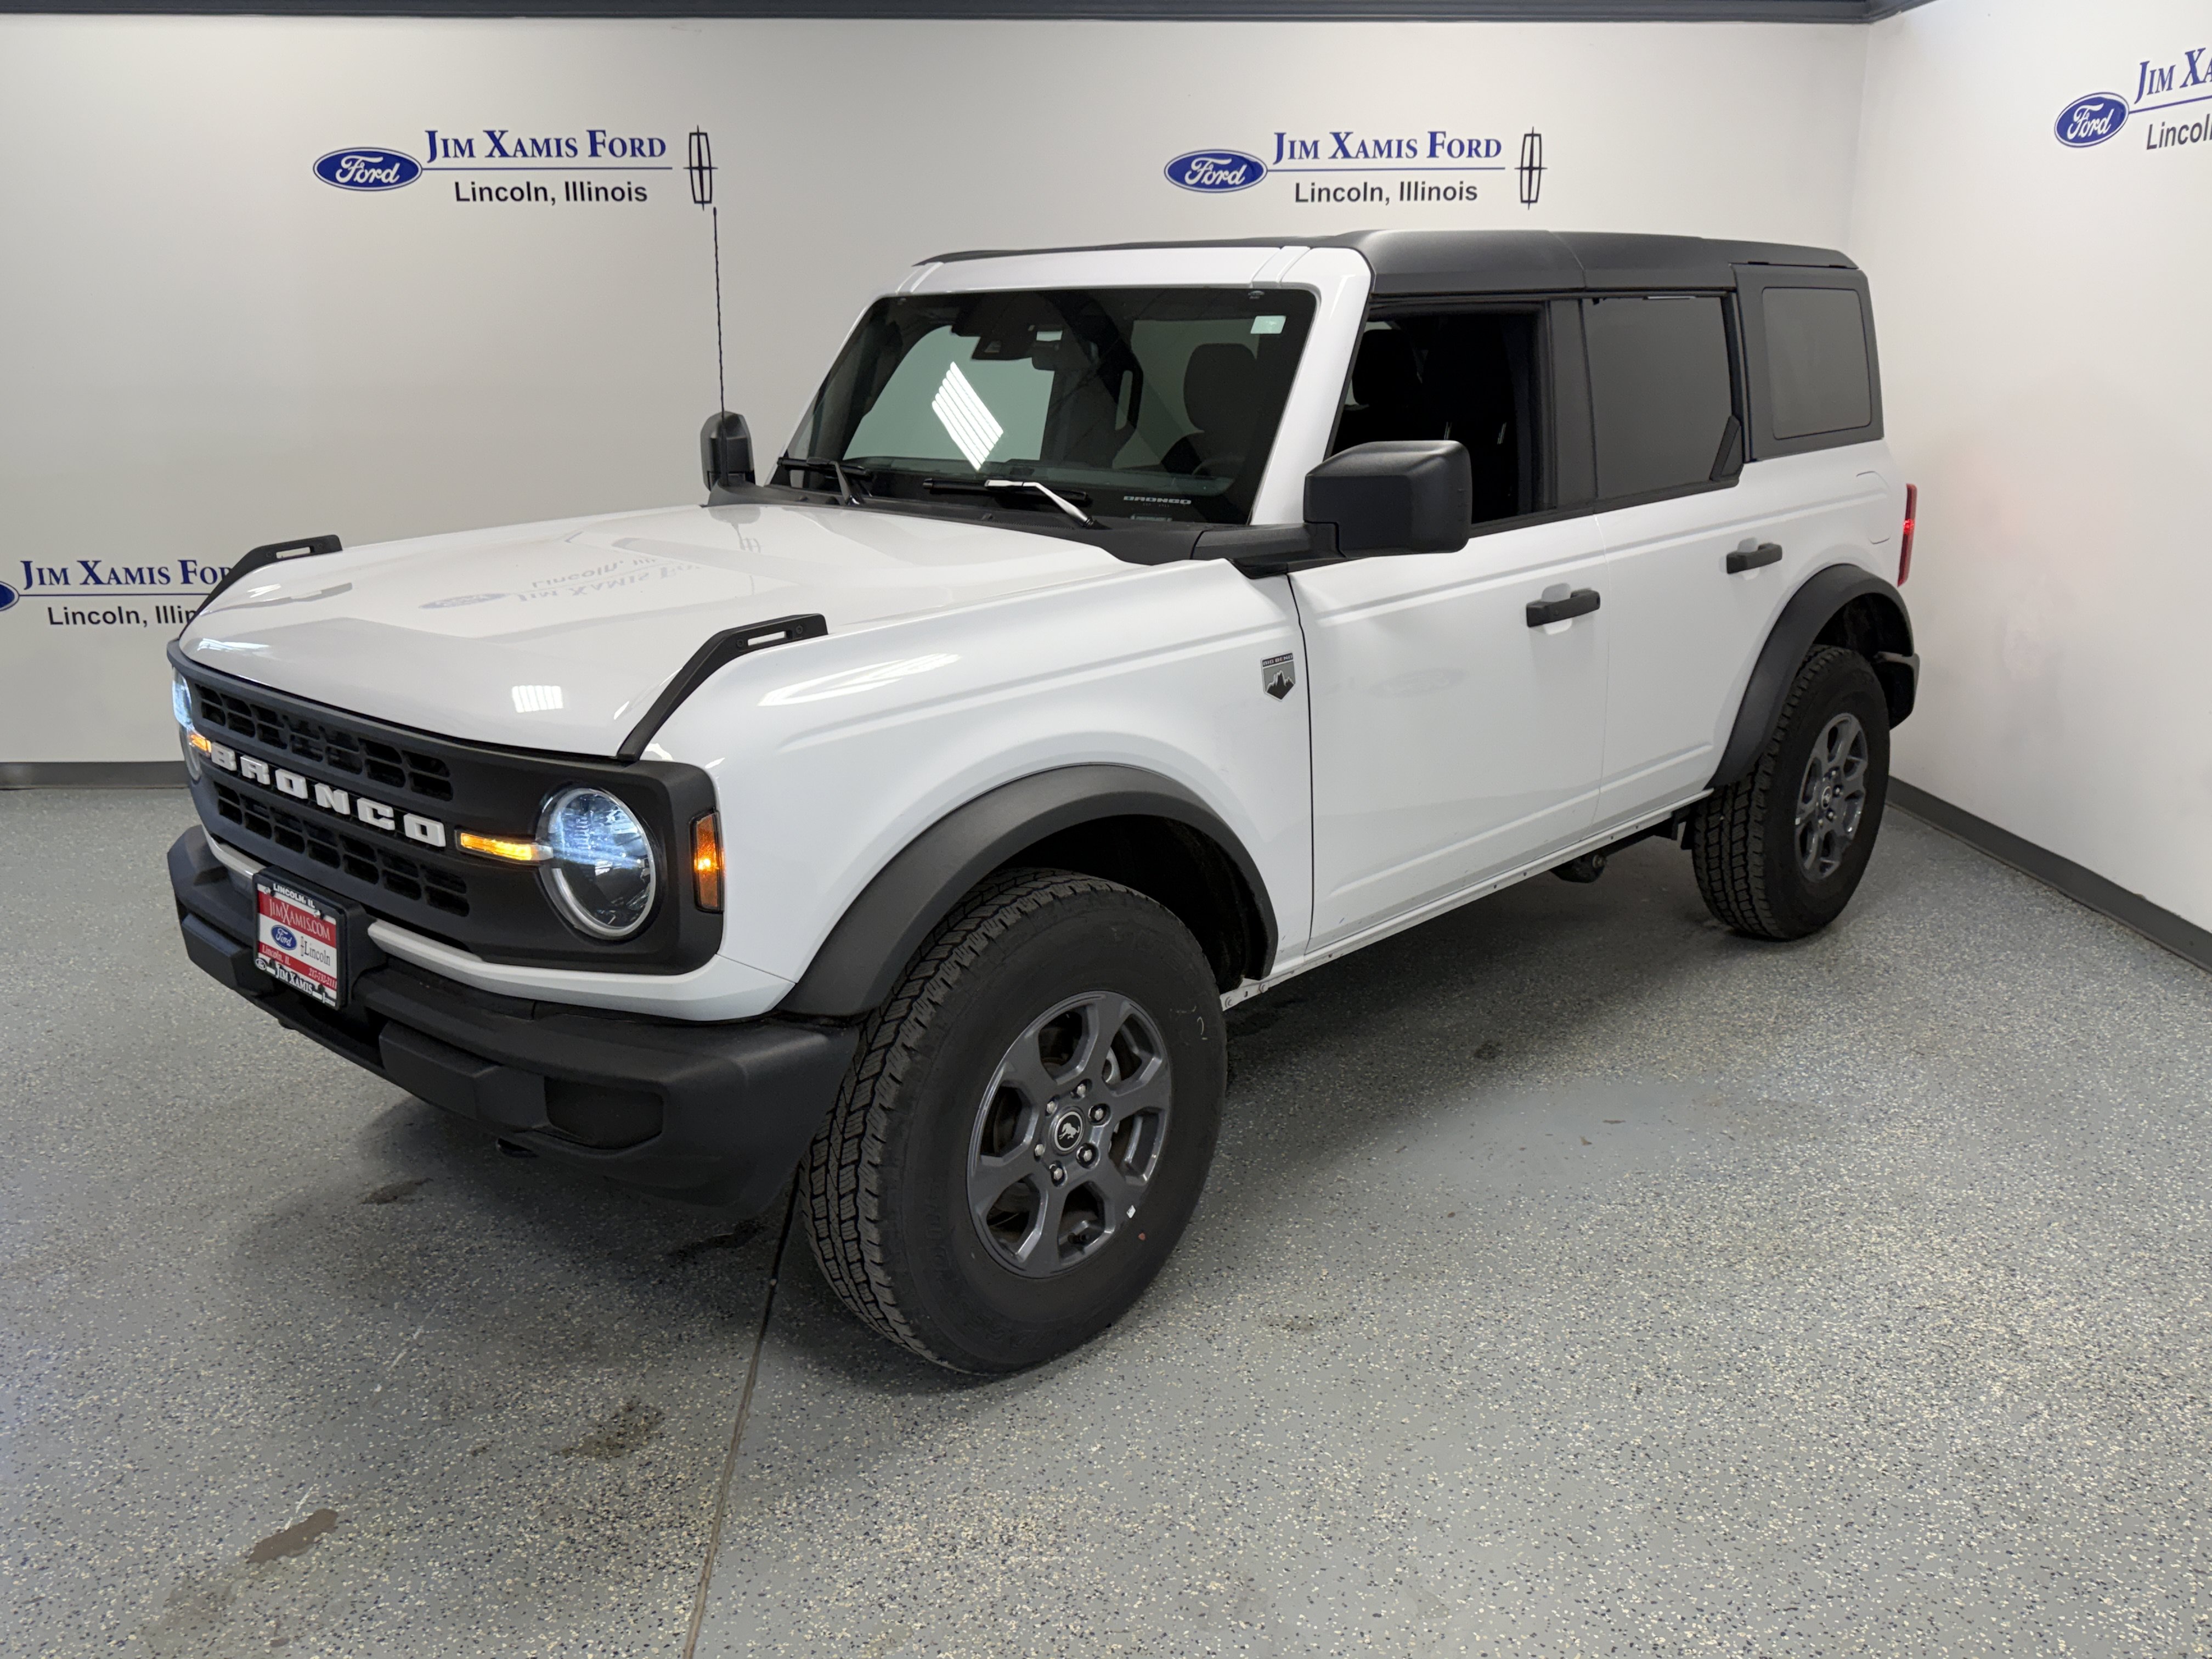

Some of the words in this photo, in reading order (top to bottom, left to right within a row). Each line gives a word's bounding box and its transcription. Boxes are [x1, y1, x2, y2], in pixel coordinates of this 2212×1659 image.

[2134, 61, 2176, 105] JIM
[2067, 103, 2115, 140] Ford
[2146, 114, 2212, 150] Lincol
[425, 129, 476, 163] JIM
[483, 130, 578, 159] XAMIS
[586, 129, 666, 158] FORD
[1273, 132, 1320, 165] JIM
[1329, 131, 1418, 160] XAMIS
[1427, 131, 1502, 159] FORD
[335, 155, 400, 184] Ford
[1184, 157, 1246, 187] Ford
[454, 181, 556, 206] Lincoln,
[565, 181, 648, 202] Illinois
[1295, 182, 1390, 207] Lincoln,
[1399, 181, 1478, 202] Illinois
[1123, 495, 1192, 505] BRONCO
[20, 560, 71, 590] JIM
[76, 560, 171, 585] XAMIS
[48, 606, 148, 627] Lincoln,
[211, 741, 447, 848] BRONCO
[308, 899, 315, 909] IL
[275, 928, 293, 947] Ford
[285, 957, 291, 966] IL
[304, 940, 331, 967] Lincoln
[275, 964, 289, 979] JIM
[289, 970, 313, 995] XAMIS
